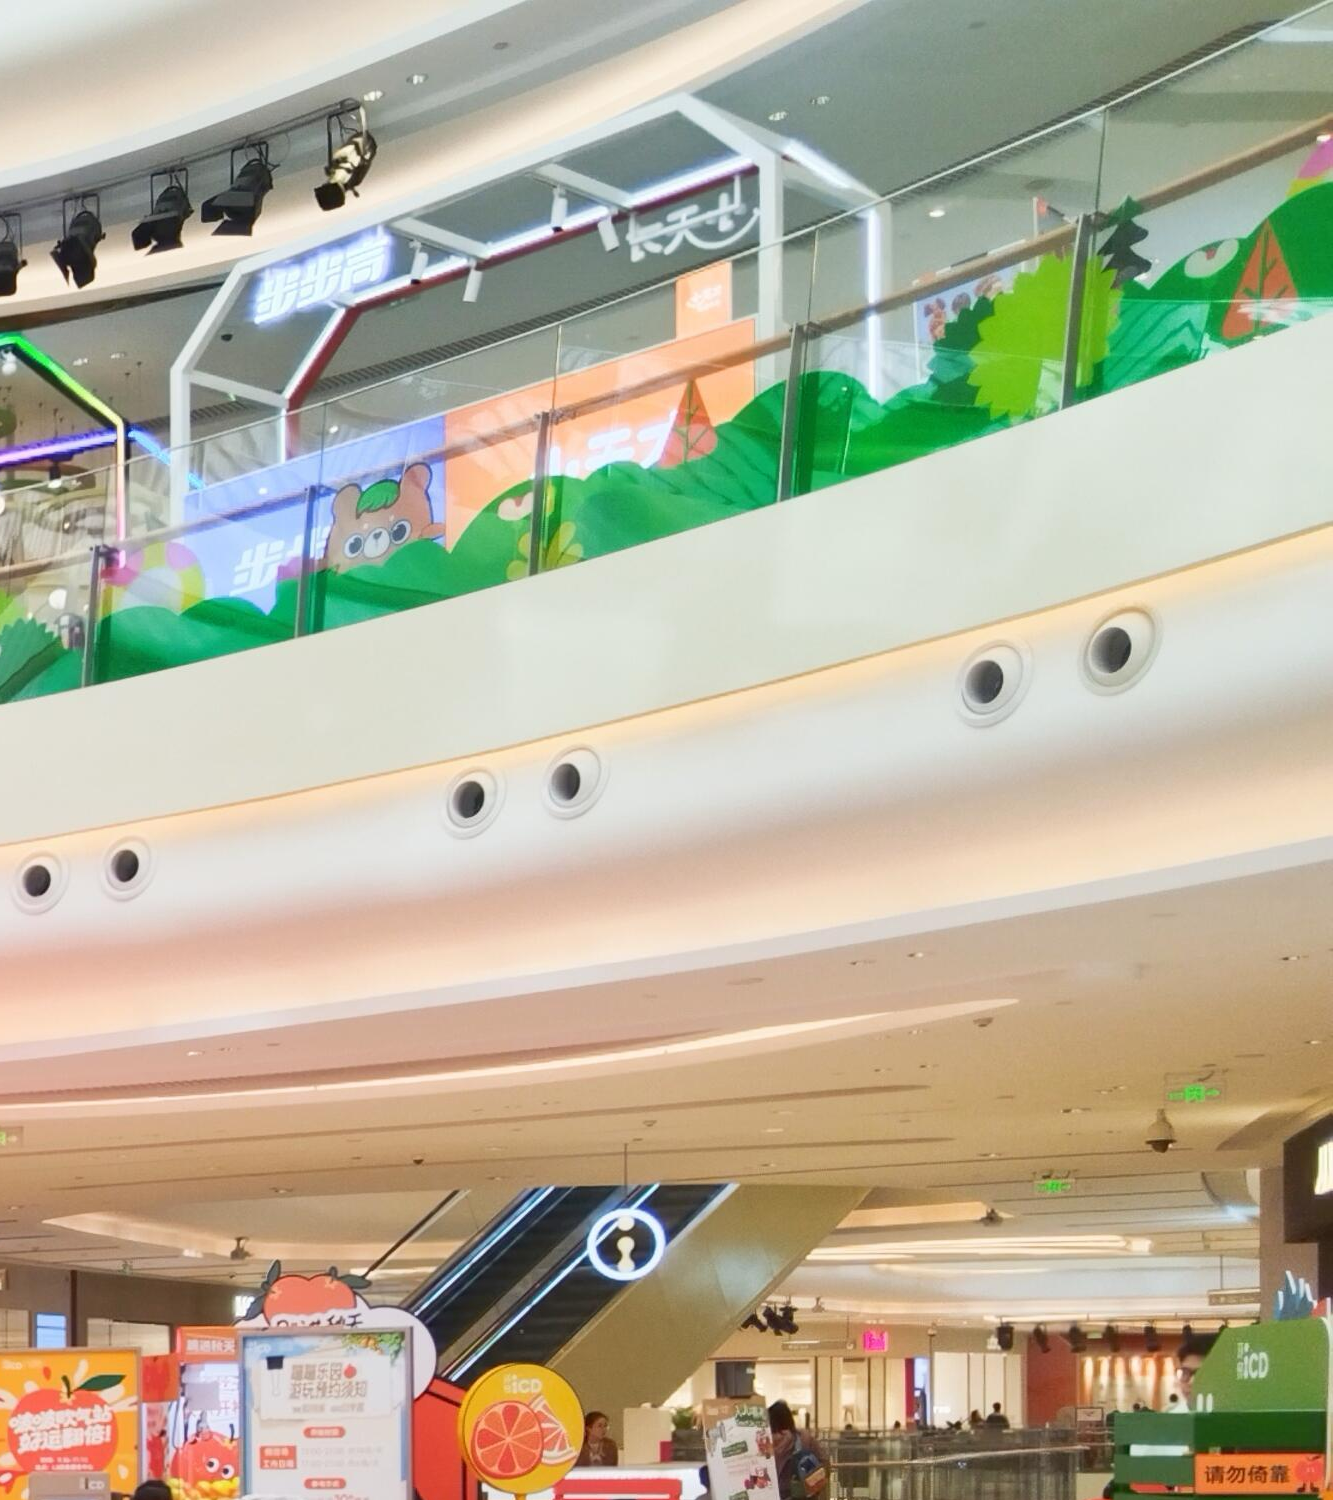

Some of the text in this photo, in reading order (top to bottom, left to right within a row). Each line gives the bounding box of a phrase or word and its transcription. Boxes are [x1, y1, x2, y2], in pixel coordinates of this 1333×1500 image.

[253, 225, 391, 324] 步步高
[1243, 1342, 1269, 1379] iCD
[1204, 1465, 1290, 1485] 请勿倚靠
